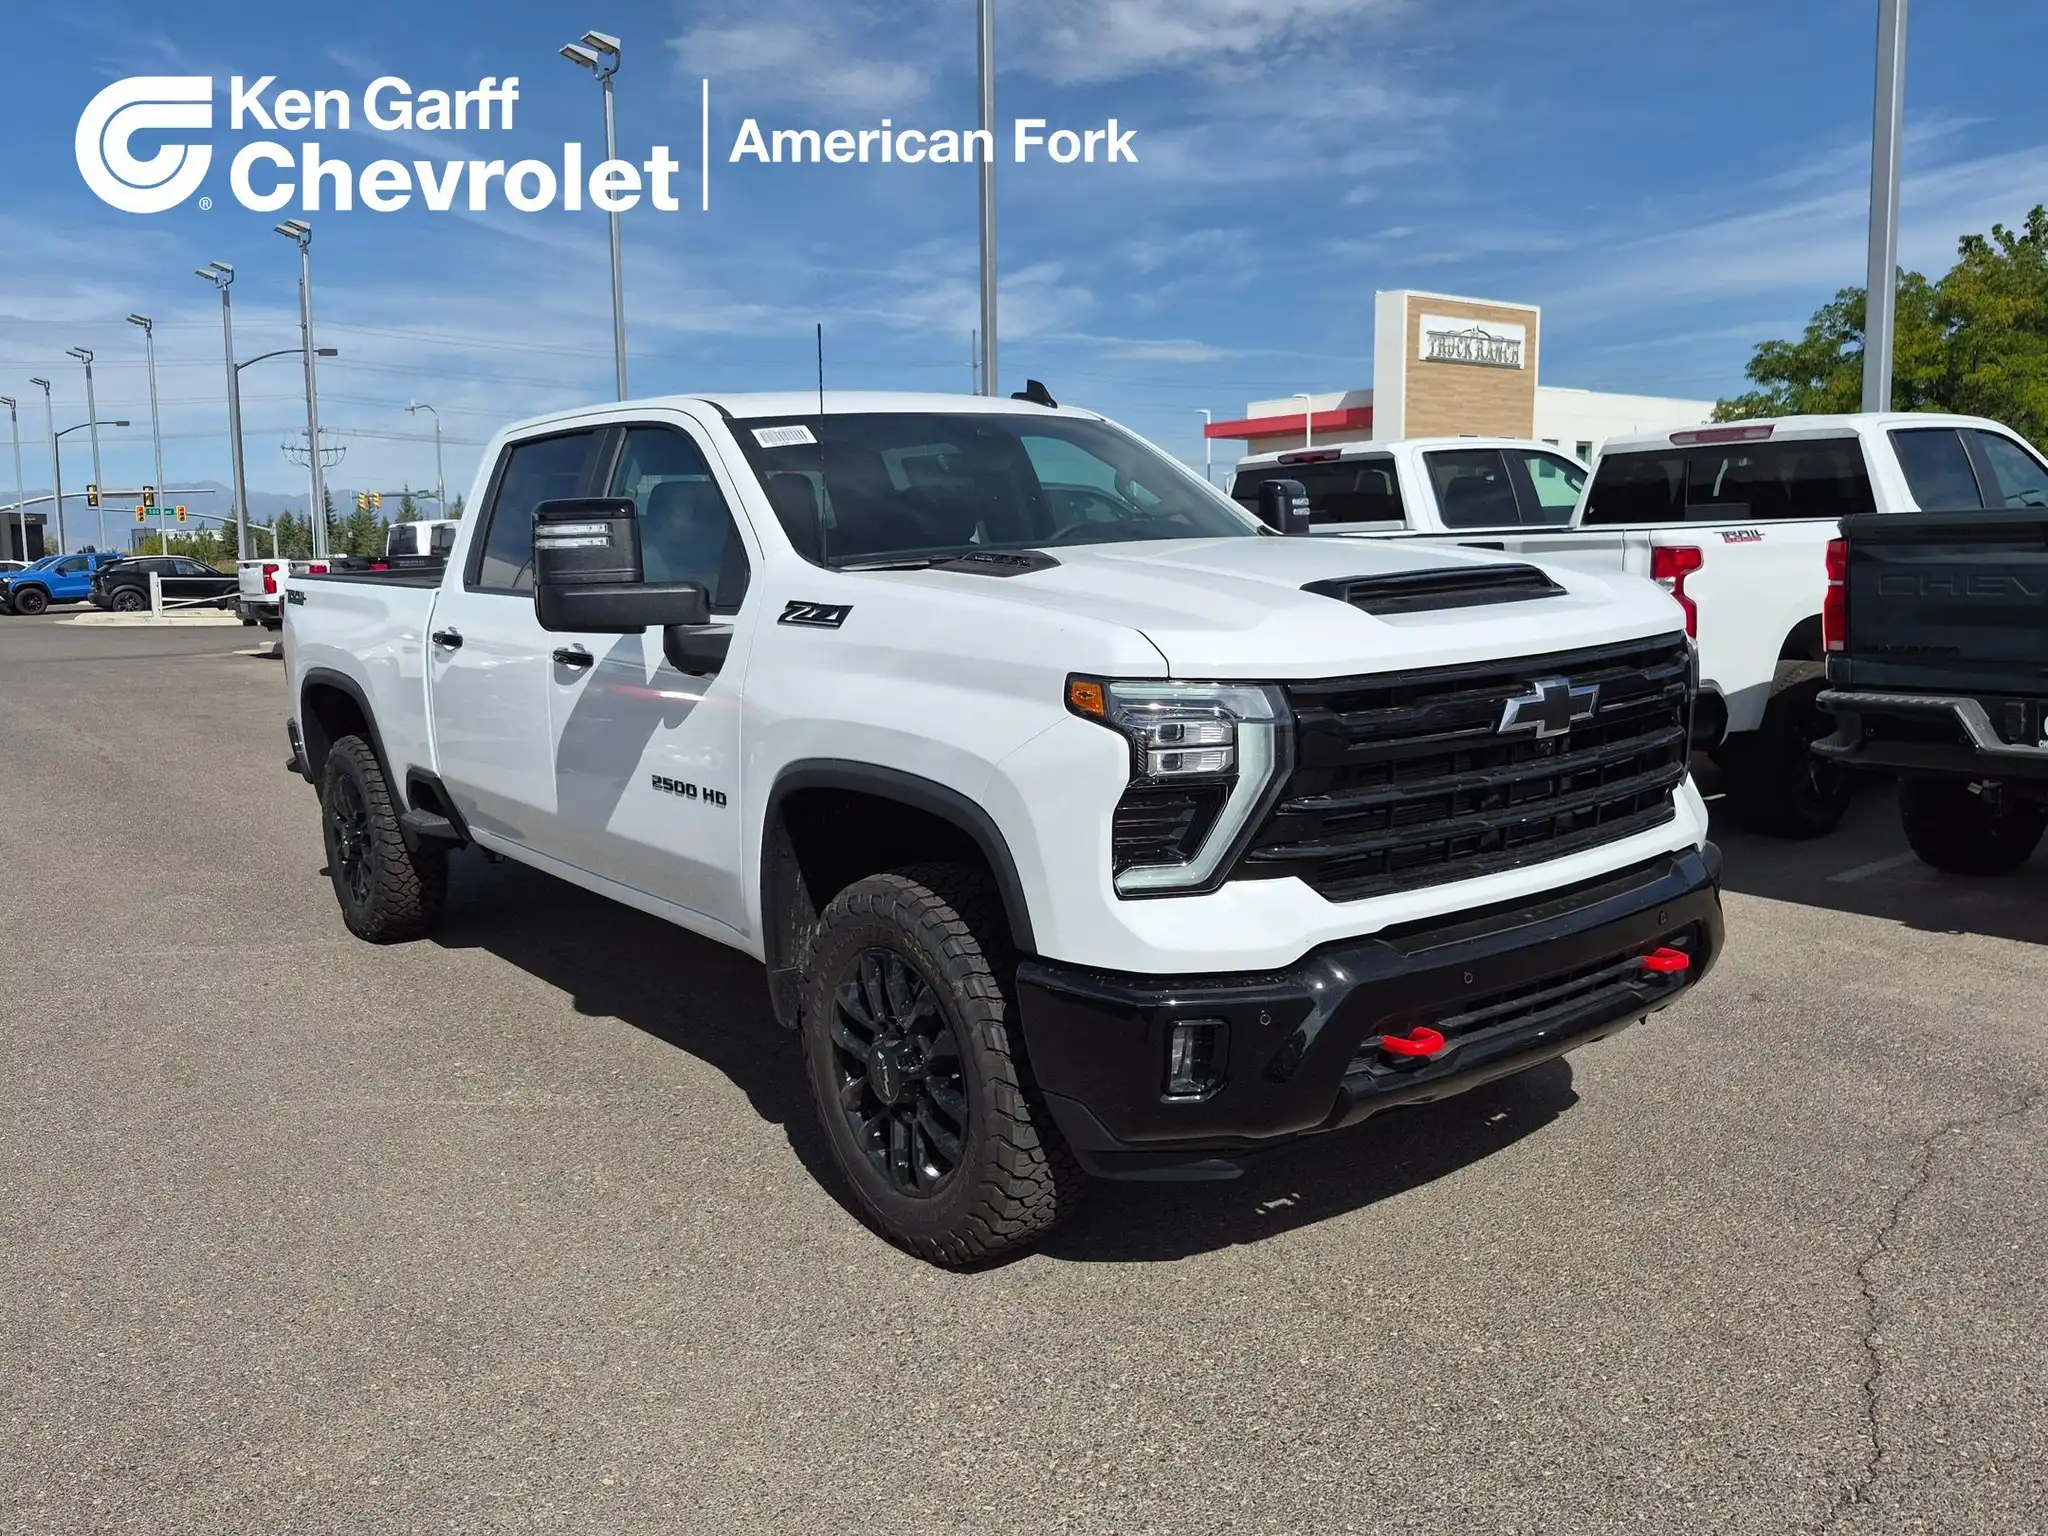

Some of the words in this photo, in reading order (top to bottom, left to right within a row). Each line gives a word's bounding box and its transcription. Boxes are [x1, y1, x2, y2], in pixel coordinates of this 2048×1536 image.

[1475, 338, 1520, 364] RANCH
[651, 774, 698, 800] 2500
[702, 786, 728, 809] HD
